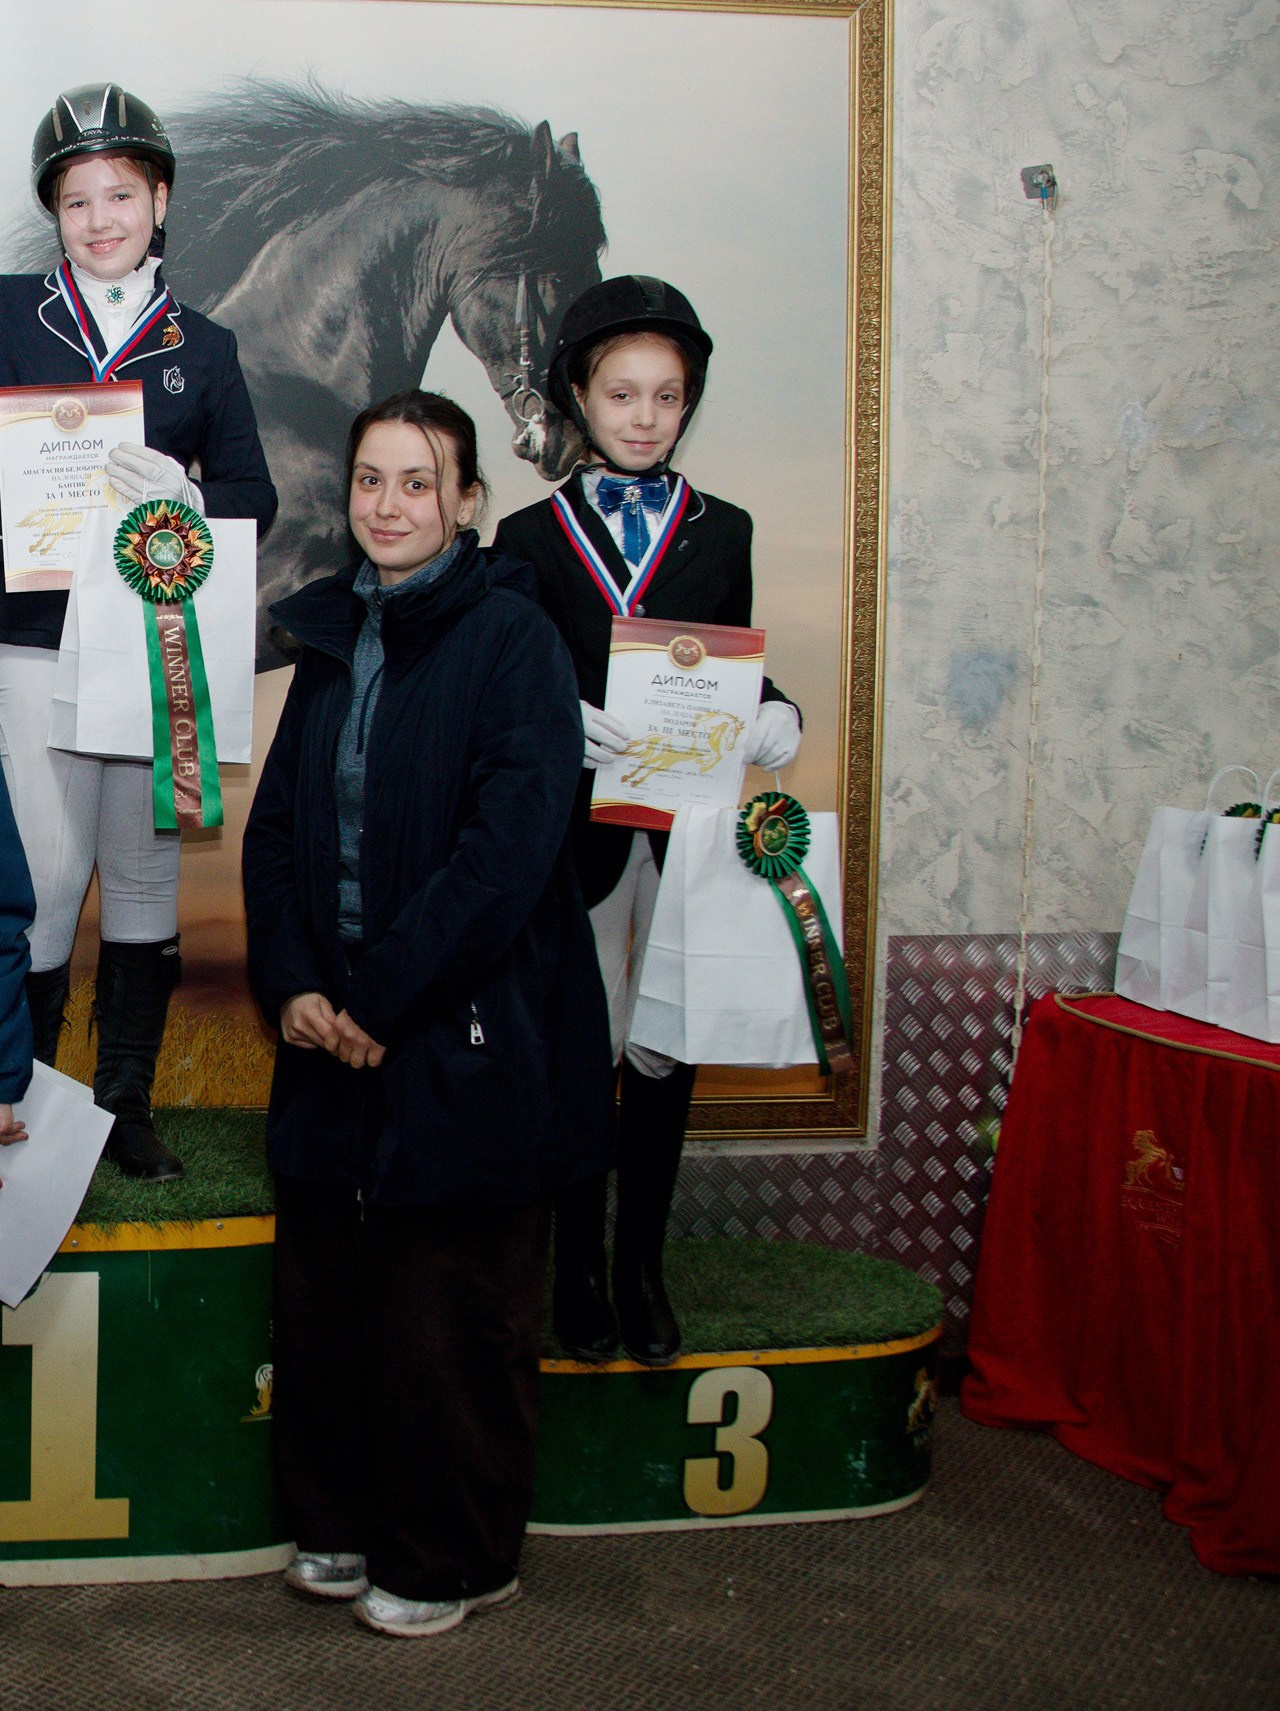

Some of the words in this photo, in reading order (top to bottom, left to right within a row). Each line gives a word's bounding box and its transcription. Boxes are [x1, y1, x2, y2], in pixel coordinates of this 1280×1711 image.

[40, 439, 103, 454] ДИПЛОМ
[68, 490, 100, 498] МЕСТО
[164, 626, 190, 712] WINNER
[651, 674, 718, 691] ДИПЛОМ
[174, 720, 195, 778] CLUB
[648, 724, 658, 732] ЗА
[678, 728, 711, 740] МЕСТО
[795, 902, 826, 975] WINNER
[815, 982, 838, 1030] CLUB
[683, 1366, 773, 1516] 3
